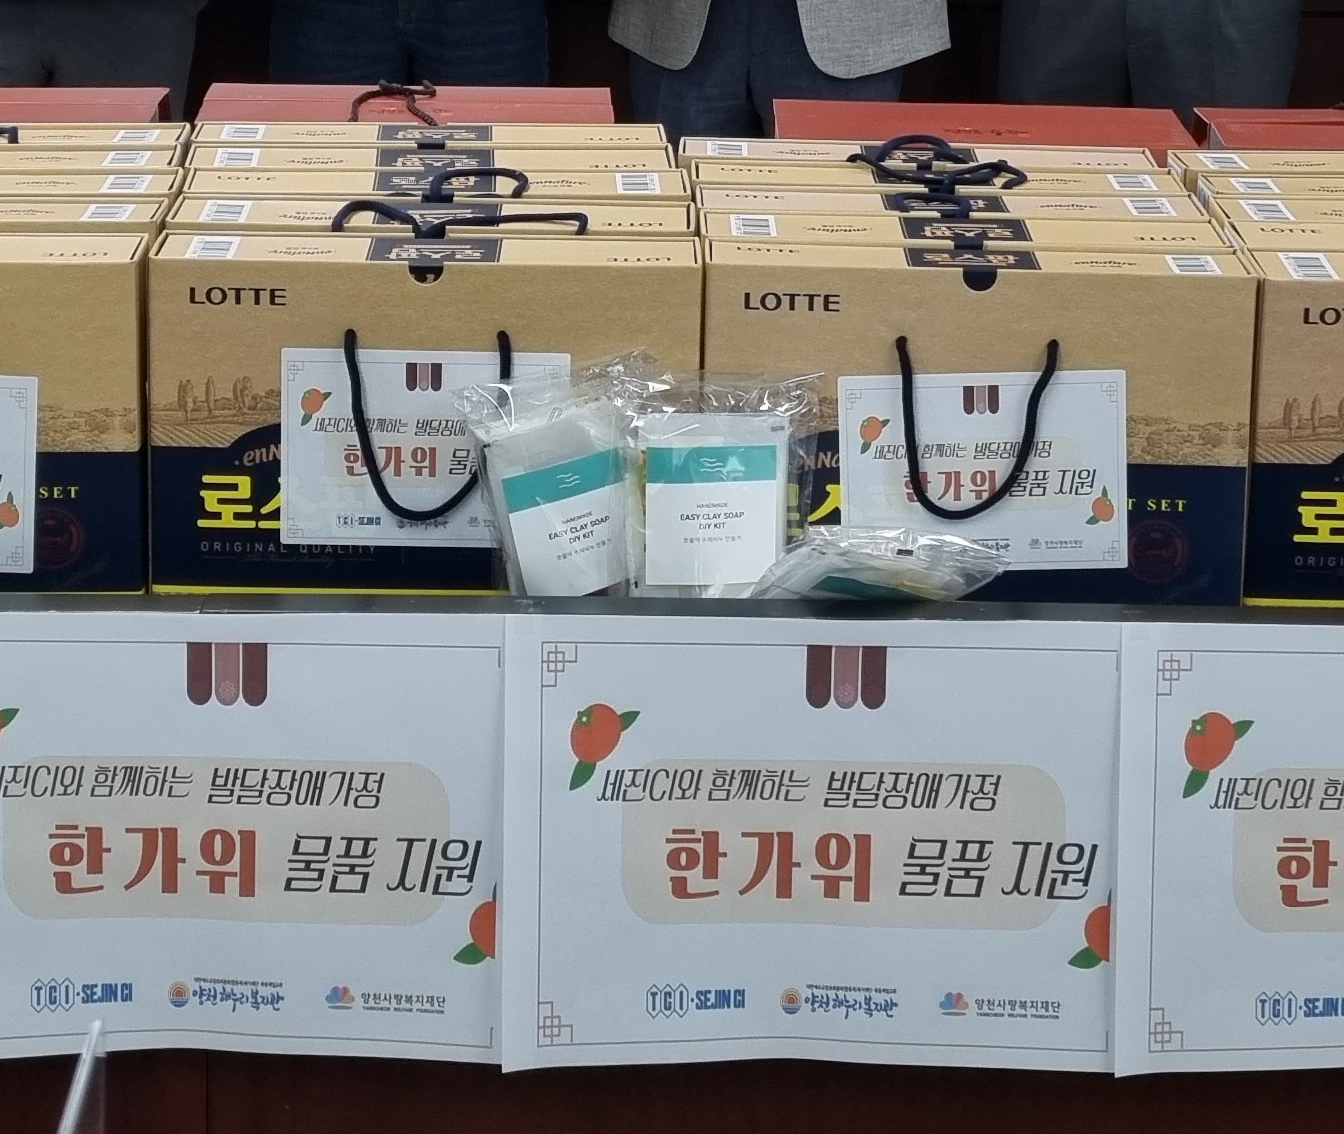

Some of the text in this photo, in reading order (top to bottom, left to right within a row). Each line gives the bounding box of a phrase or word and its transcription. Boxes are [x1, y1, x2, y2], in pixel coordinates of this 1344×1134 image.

[1259, 226, 1323, 235] LOTTE
[188, 285, 288, 307] LOTTE
[742, 291, 841, 313] LOTTE
[920, 442, 968, 460] 함께하는
[38, 485, 80, 499] SET
[1053, 468, 1097, 496] 지원
[1147, 497, 1188, 513] SET
[548, 514, 610, 541] EASY CLAY SOAP
[680, 511, 745, 522] EASY CLAY SOAP
[698, 521, 727, 531] DIY KIT
[200, 541, 288, 553] ORIGINAL
[568, 530, 595, 545] DIY KIT
[89, 765, 194, 800] 함께하는
[206, 767, 386, 809] 발달장애가정
[596, 768, 1002, 813] 세진CI와 함께하는 발달장애가정
[1208, 777, 1314, 812] 세진CI와
[47, 823, 483, 899] 한가위 물품 지원
[664, 828, 1099, 904] 한가위 물품 지원
[649, 988, 688, 1016] TCI
[973, 997, 1062, 1015] 양천사랑복지재단
